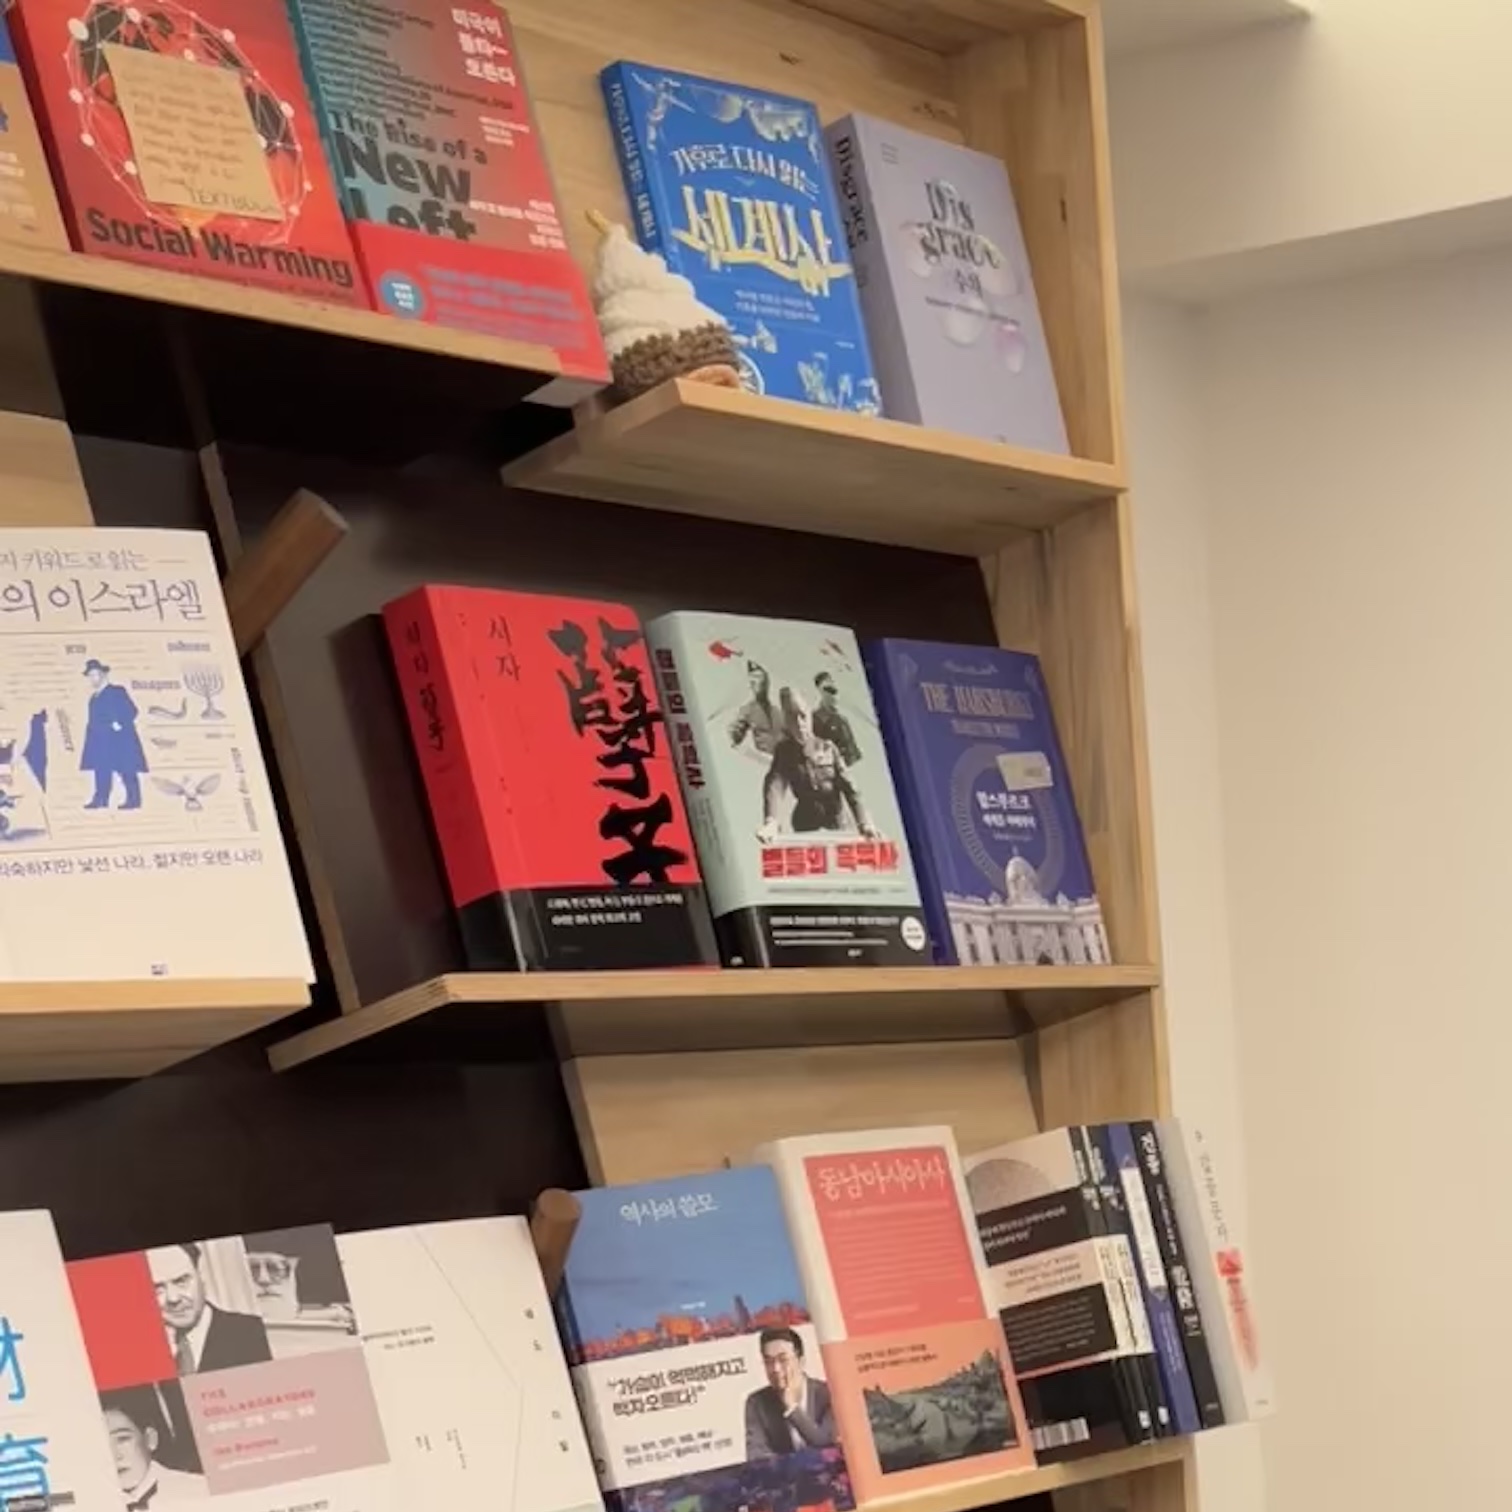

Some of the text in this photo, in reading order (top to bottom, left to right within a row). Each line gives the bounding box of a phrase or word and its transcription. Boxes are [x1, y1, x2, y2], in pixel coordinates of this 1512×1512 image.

[329, 110, 488, 164] The Rise of a
[731, 144, 776, 178] 다시
[334, 130, 472, 205] New
[835, 135, 868, 242] Disgrace
[347, 186, 477, 241] Left
[924, 178, 975, 231] Dis
[85, 206, 354, 289] Social Warming
[671, 184, 852, 297] 세계사
[917, 221, 1001, 270] grace
[107, 548, 149, 572] 읽는
[1, 576, 207, 622] 의 이스라엘
[234, 847, 263, 865] 나라
[818, 1156, 946, 1202] 동남아시아사
[619, 1193, 720, 1228] 역사의 쓸모
